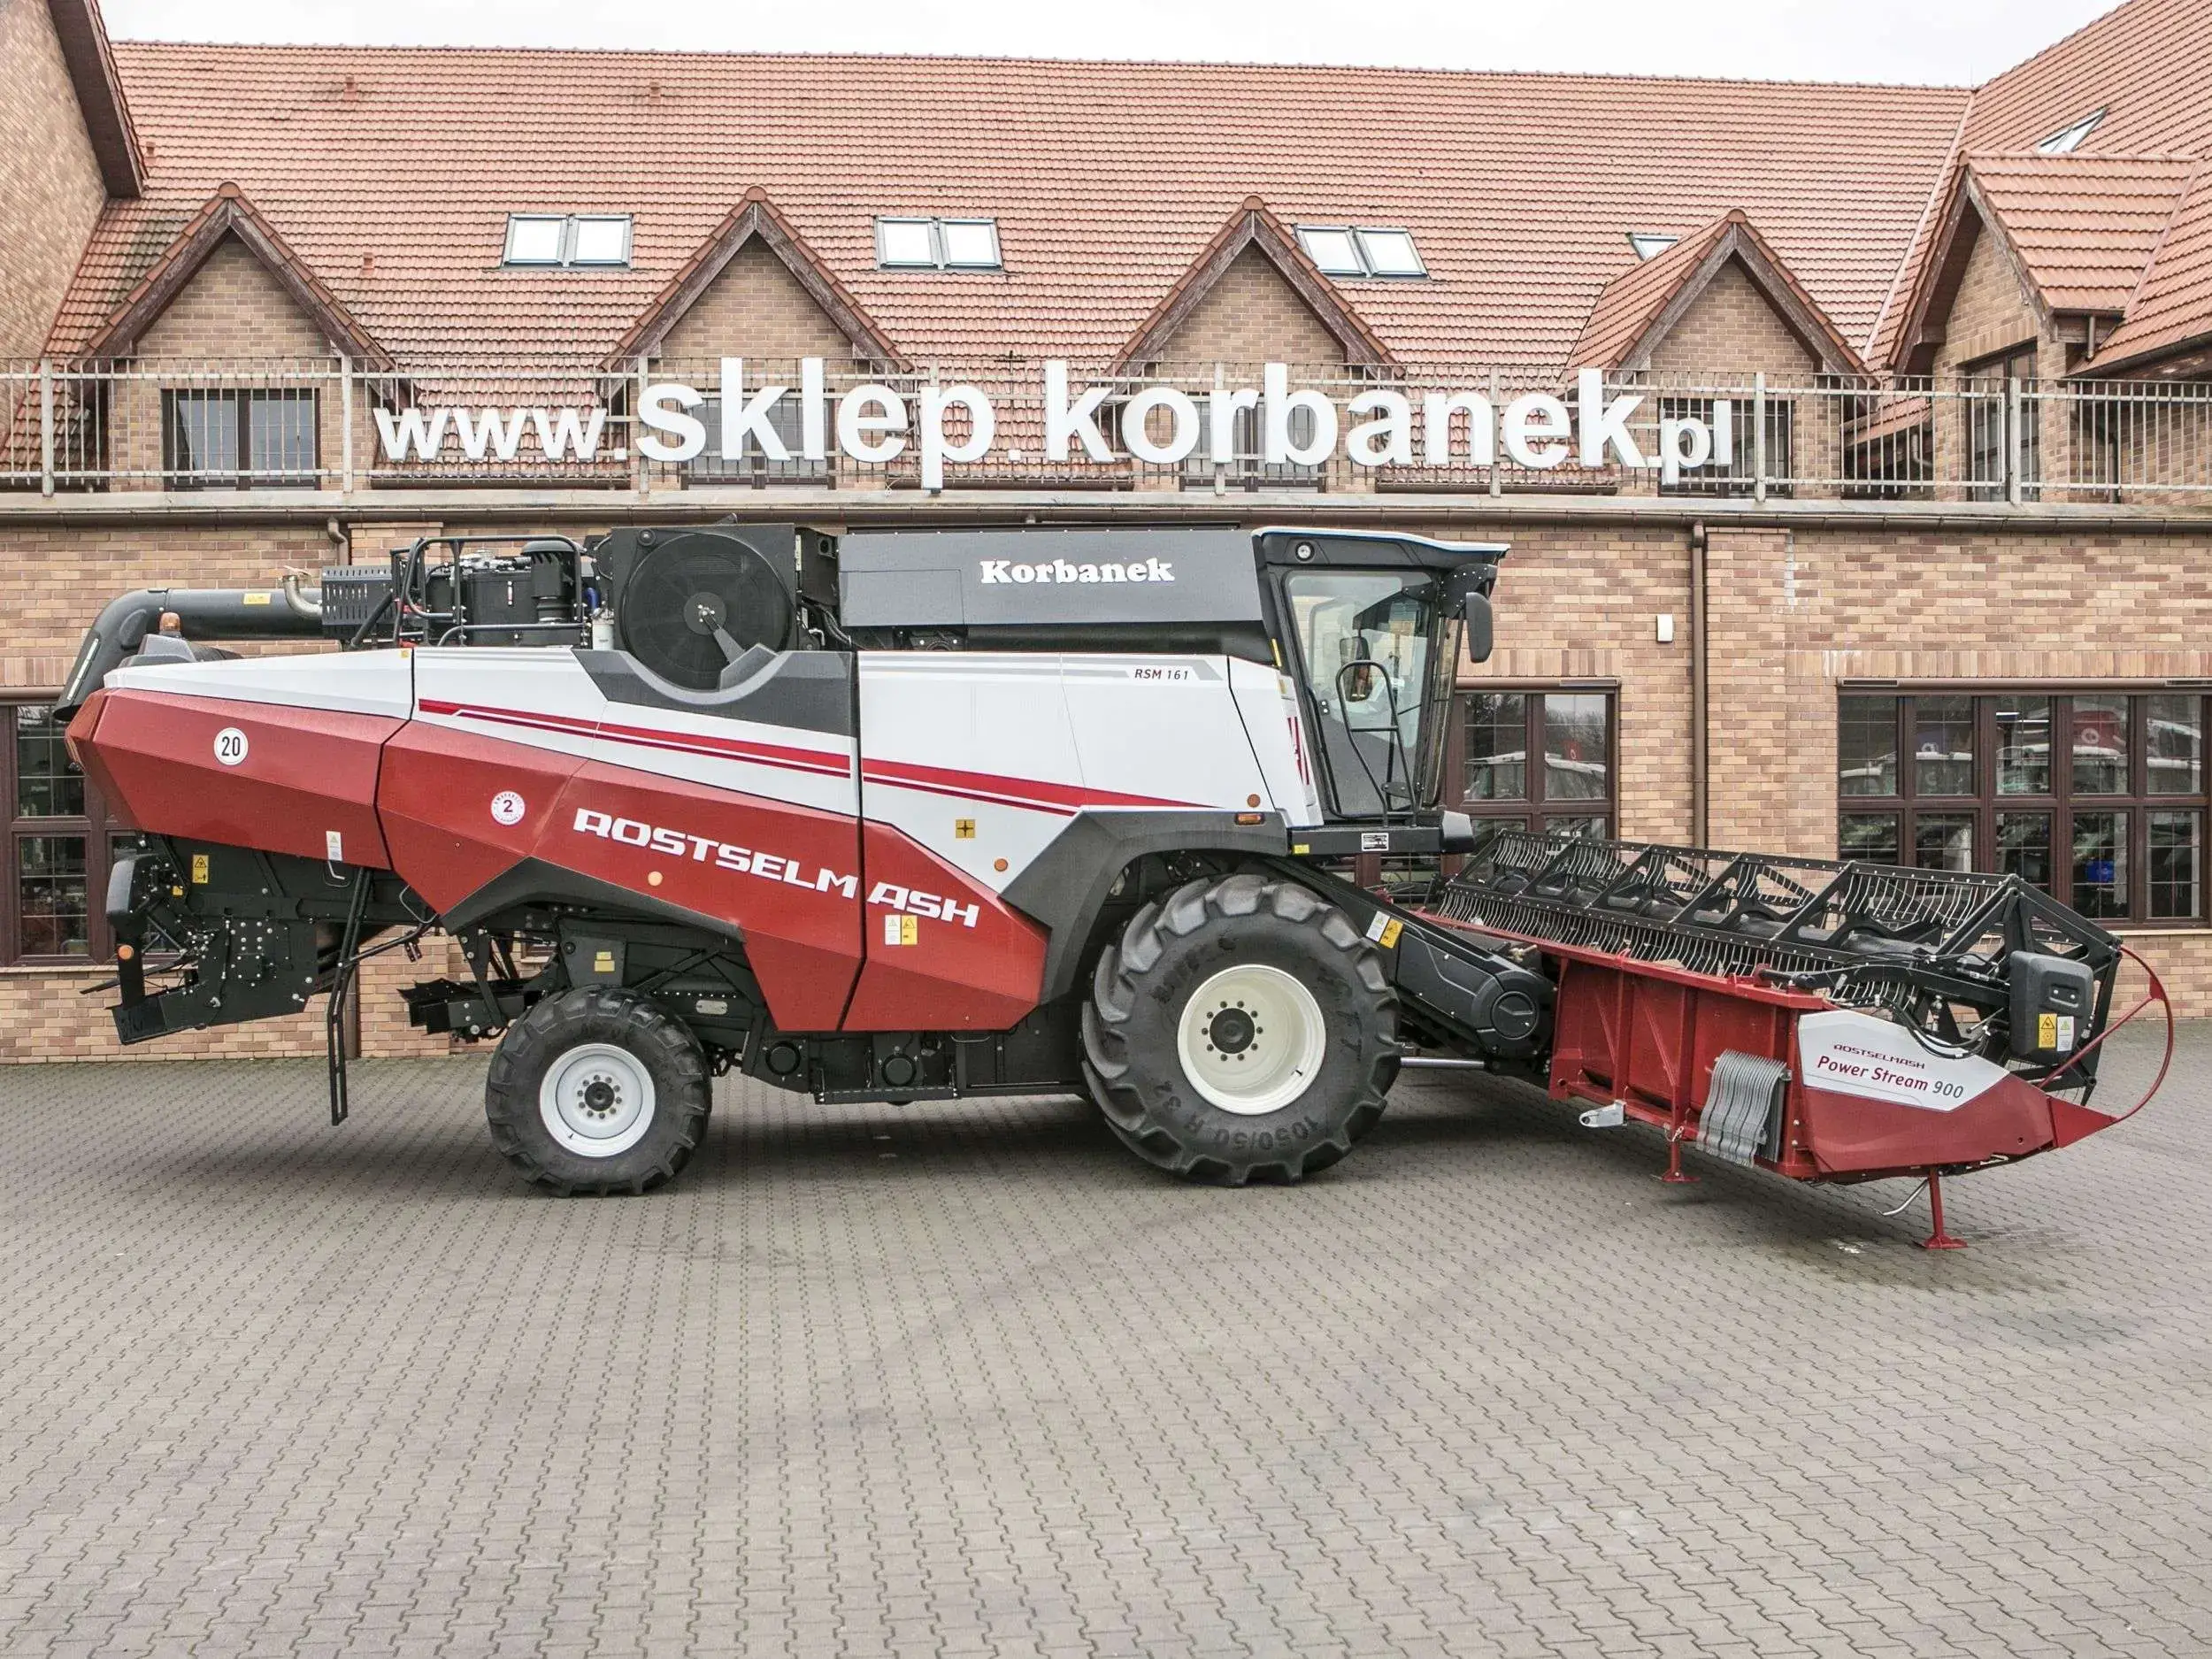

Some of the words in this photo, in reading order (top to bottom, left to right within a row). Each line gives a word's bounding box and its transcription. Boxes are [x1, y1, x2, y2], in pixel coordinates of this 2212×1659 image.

[373, 357, 1732, 490] www.sklep.korbanek.pl
[979, 557, 1175, 584] Korbanek
[1134, 668, 1162, 680] RSM
[1167, 669, 1189, 680] 161
[221, 736, 241, 757] 20
[503, 799, 513, 813] 2
[1833, 1044, 1925, 1070] ROSTSELMASH
[1816, 1056, 1869, 1078] Power
[1871, 1067, 1929, 1091] Stream
[1932, 1080, 1963, 1099] 900
